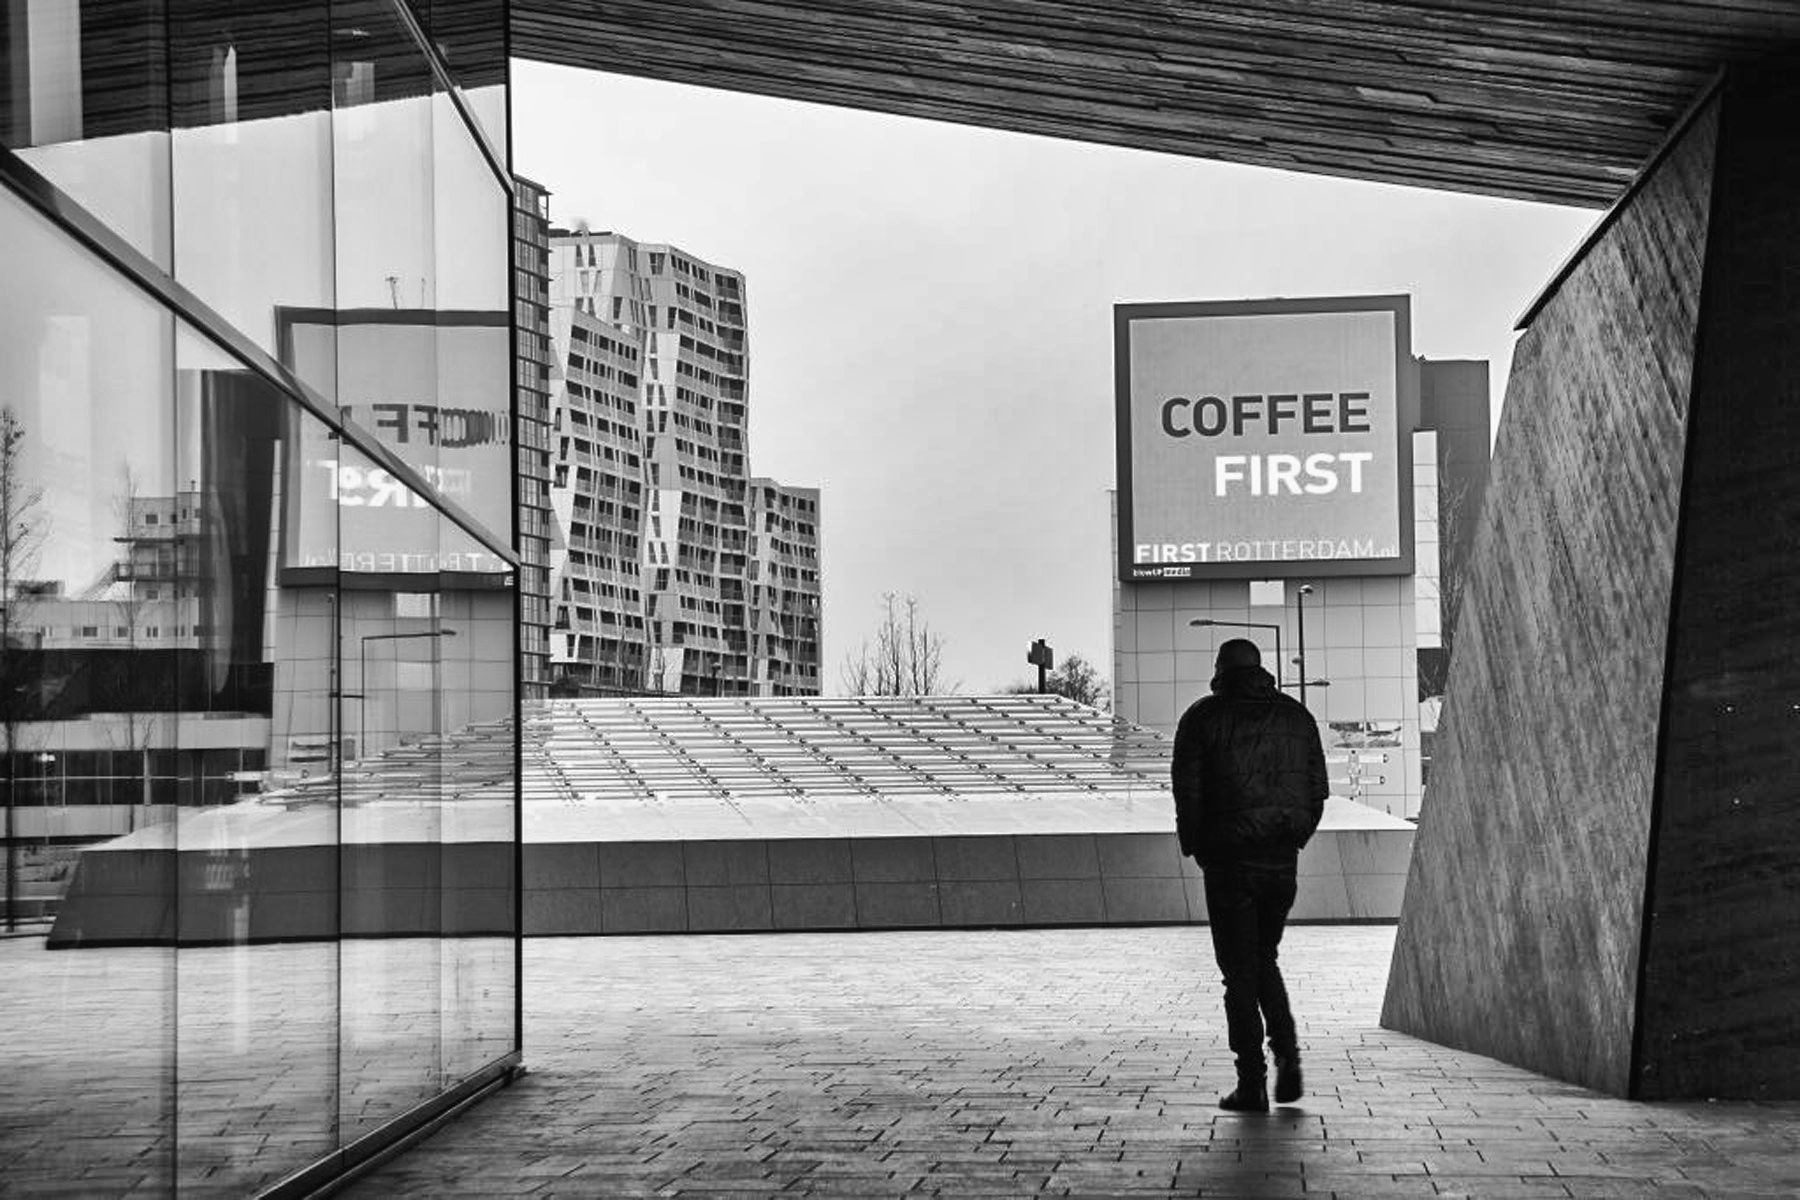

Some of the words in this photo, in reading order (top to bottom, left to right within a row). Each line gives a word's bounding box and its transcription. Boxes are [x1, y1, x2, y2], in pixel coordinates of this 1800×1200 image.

[1161, 392, 1371, 438] COFFEE
[1214, 452, 1374, 497] FIRST
[1136, 542, 1211, 563] FIRST
